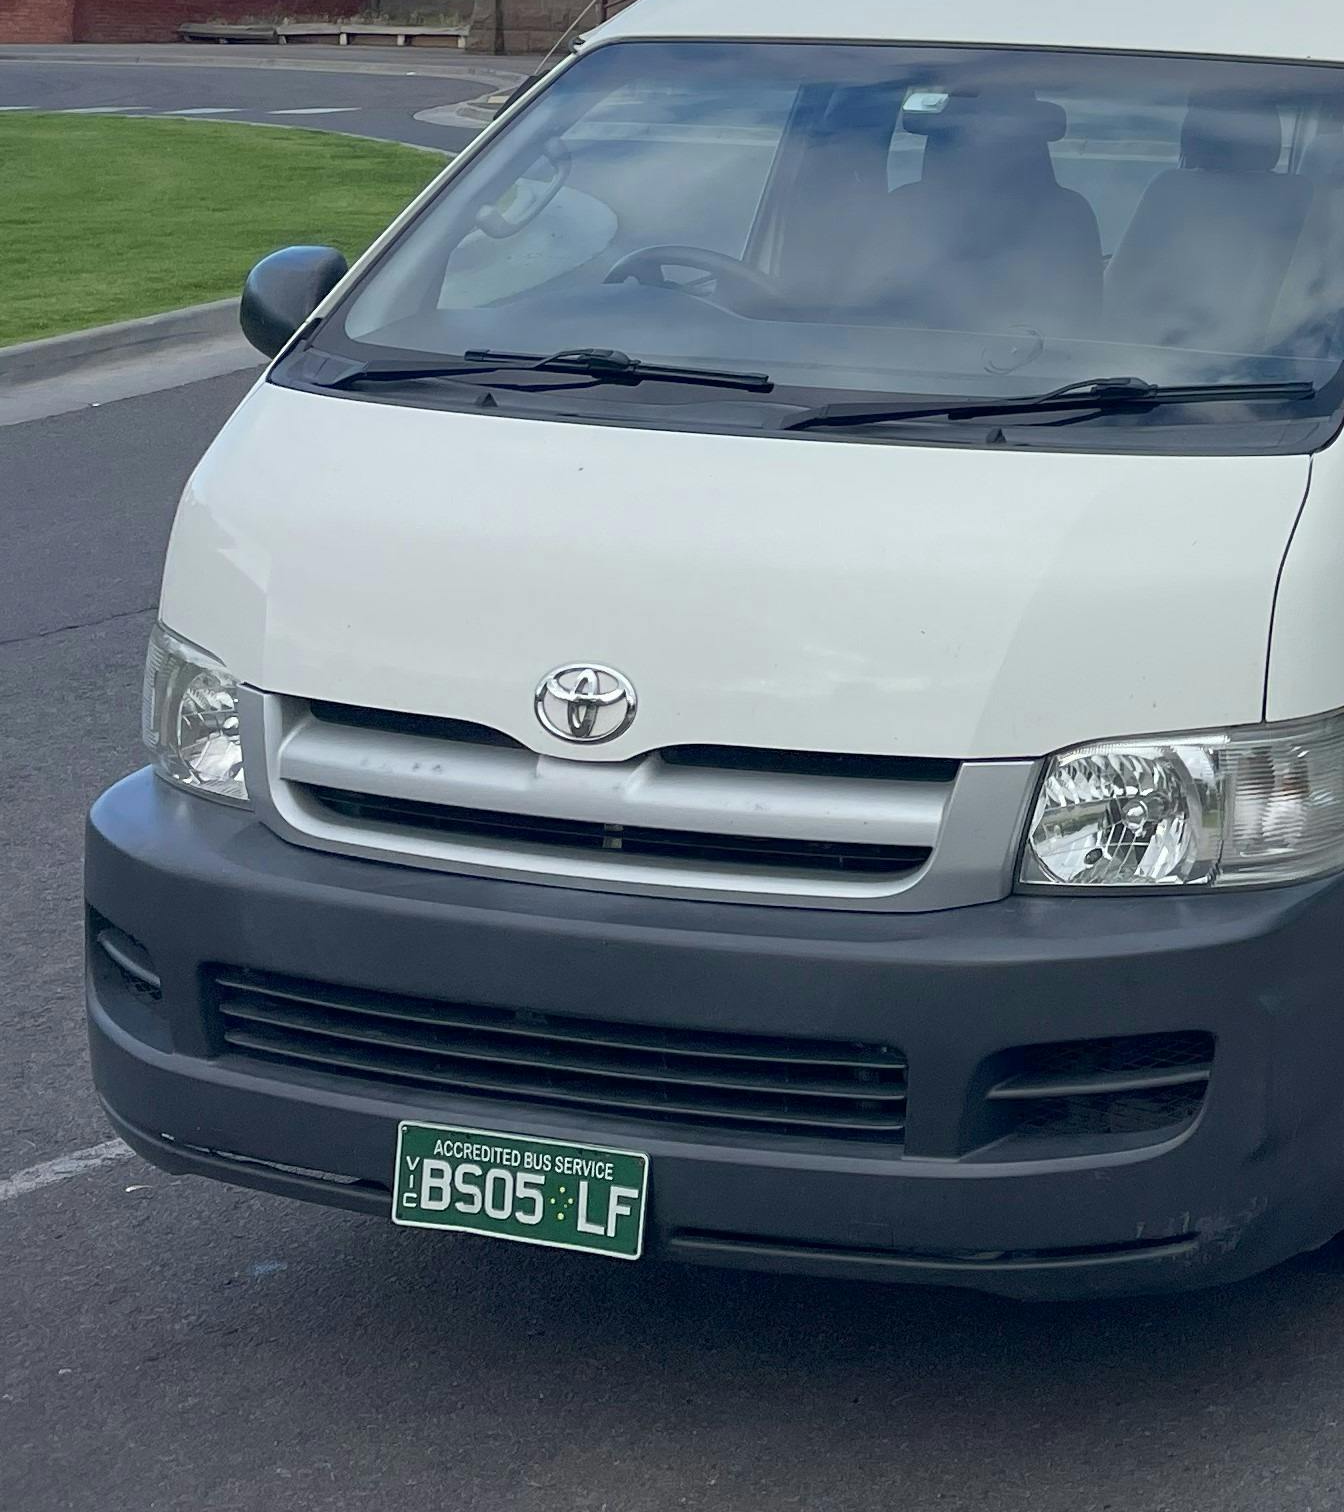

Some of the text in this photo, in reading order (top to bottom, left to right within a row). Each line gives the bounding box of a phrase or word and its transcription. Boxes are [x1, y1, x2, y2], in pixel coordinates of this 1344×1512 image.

[402, 1155, 420, 1208] VIC
[433, 1139, 614, 1181] ACCREDITED BUS SERVICE
[420, 1158, 640, 1238] BS05 LF
